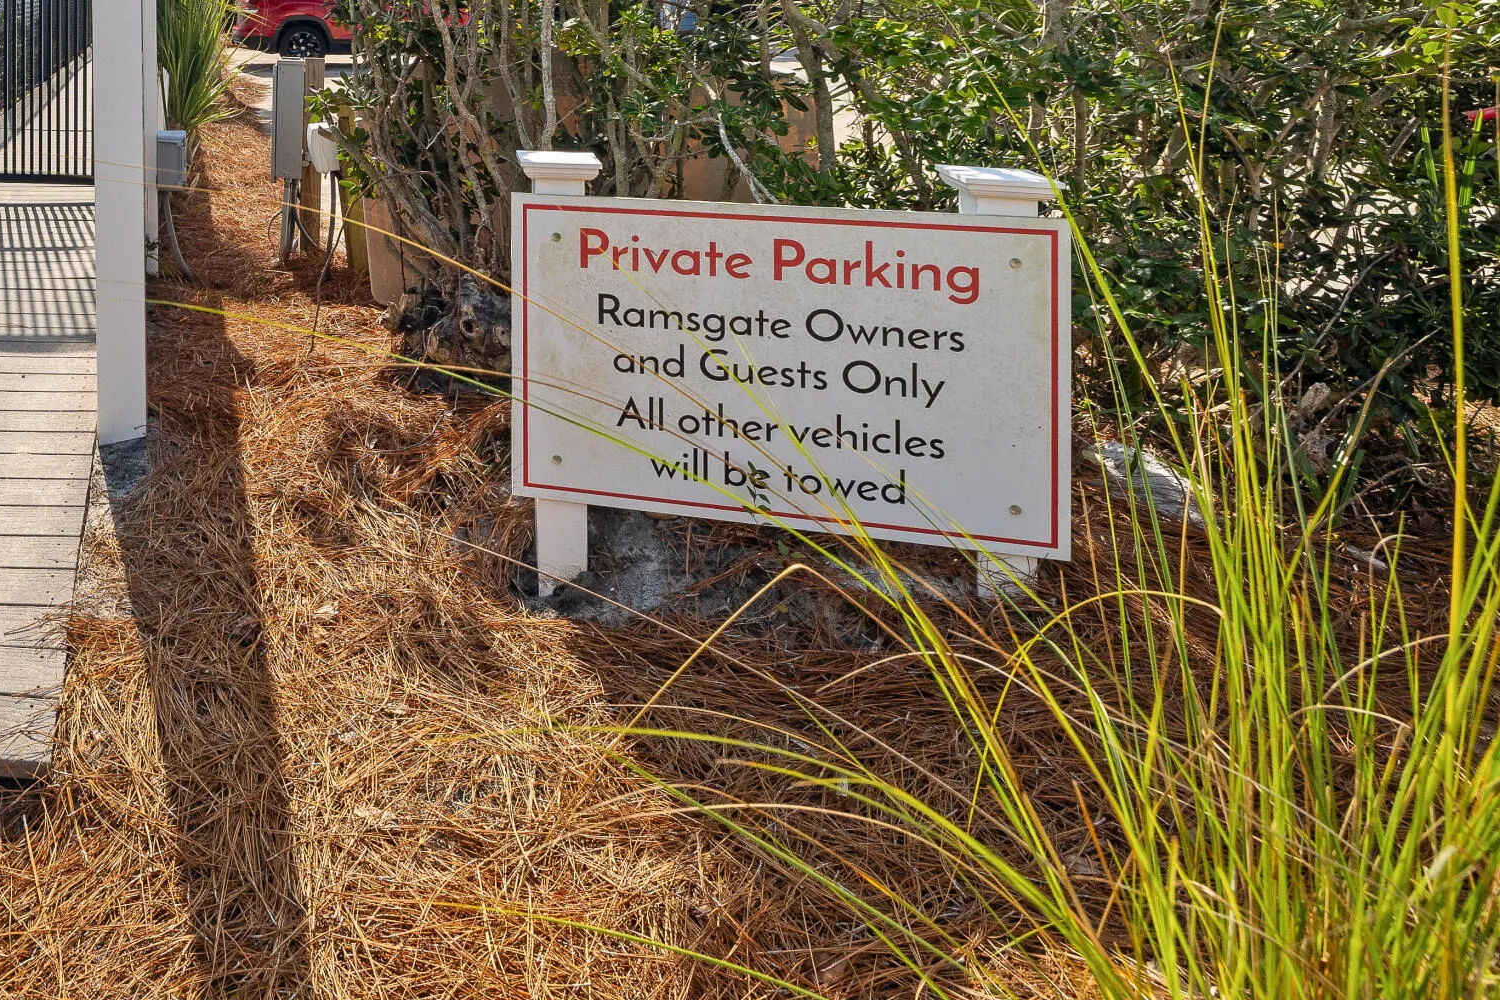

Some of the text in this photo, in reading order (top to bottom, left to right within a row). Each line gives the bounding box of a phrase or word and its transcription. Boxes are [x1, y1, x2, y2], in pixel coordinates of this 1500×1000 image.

[579, 228, 981, 305] Private Parking
[598, 294, 965, 353] Ramsgate Owners
[613, 344, 945, 408] and Guests Only
[617, 397, 945, 459] All other vehicles
[650, 449, 905, 505] will be towed
